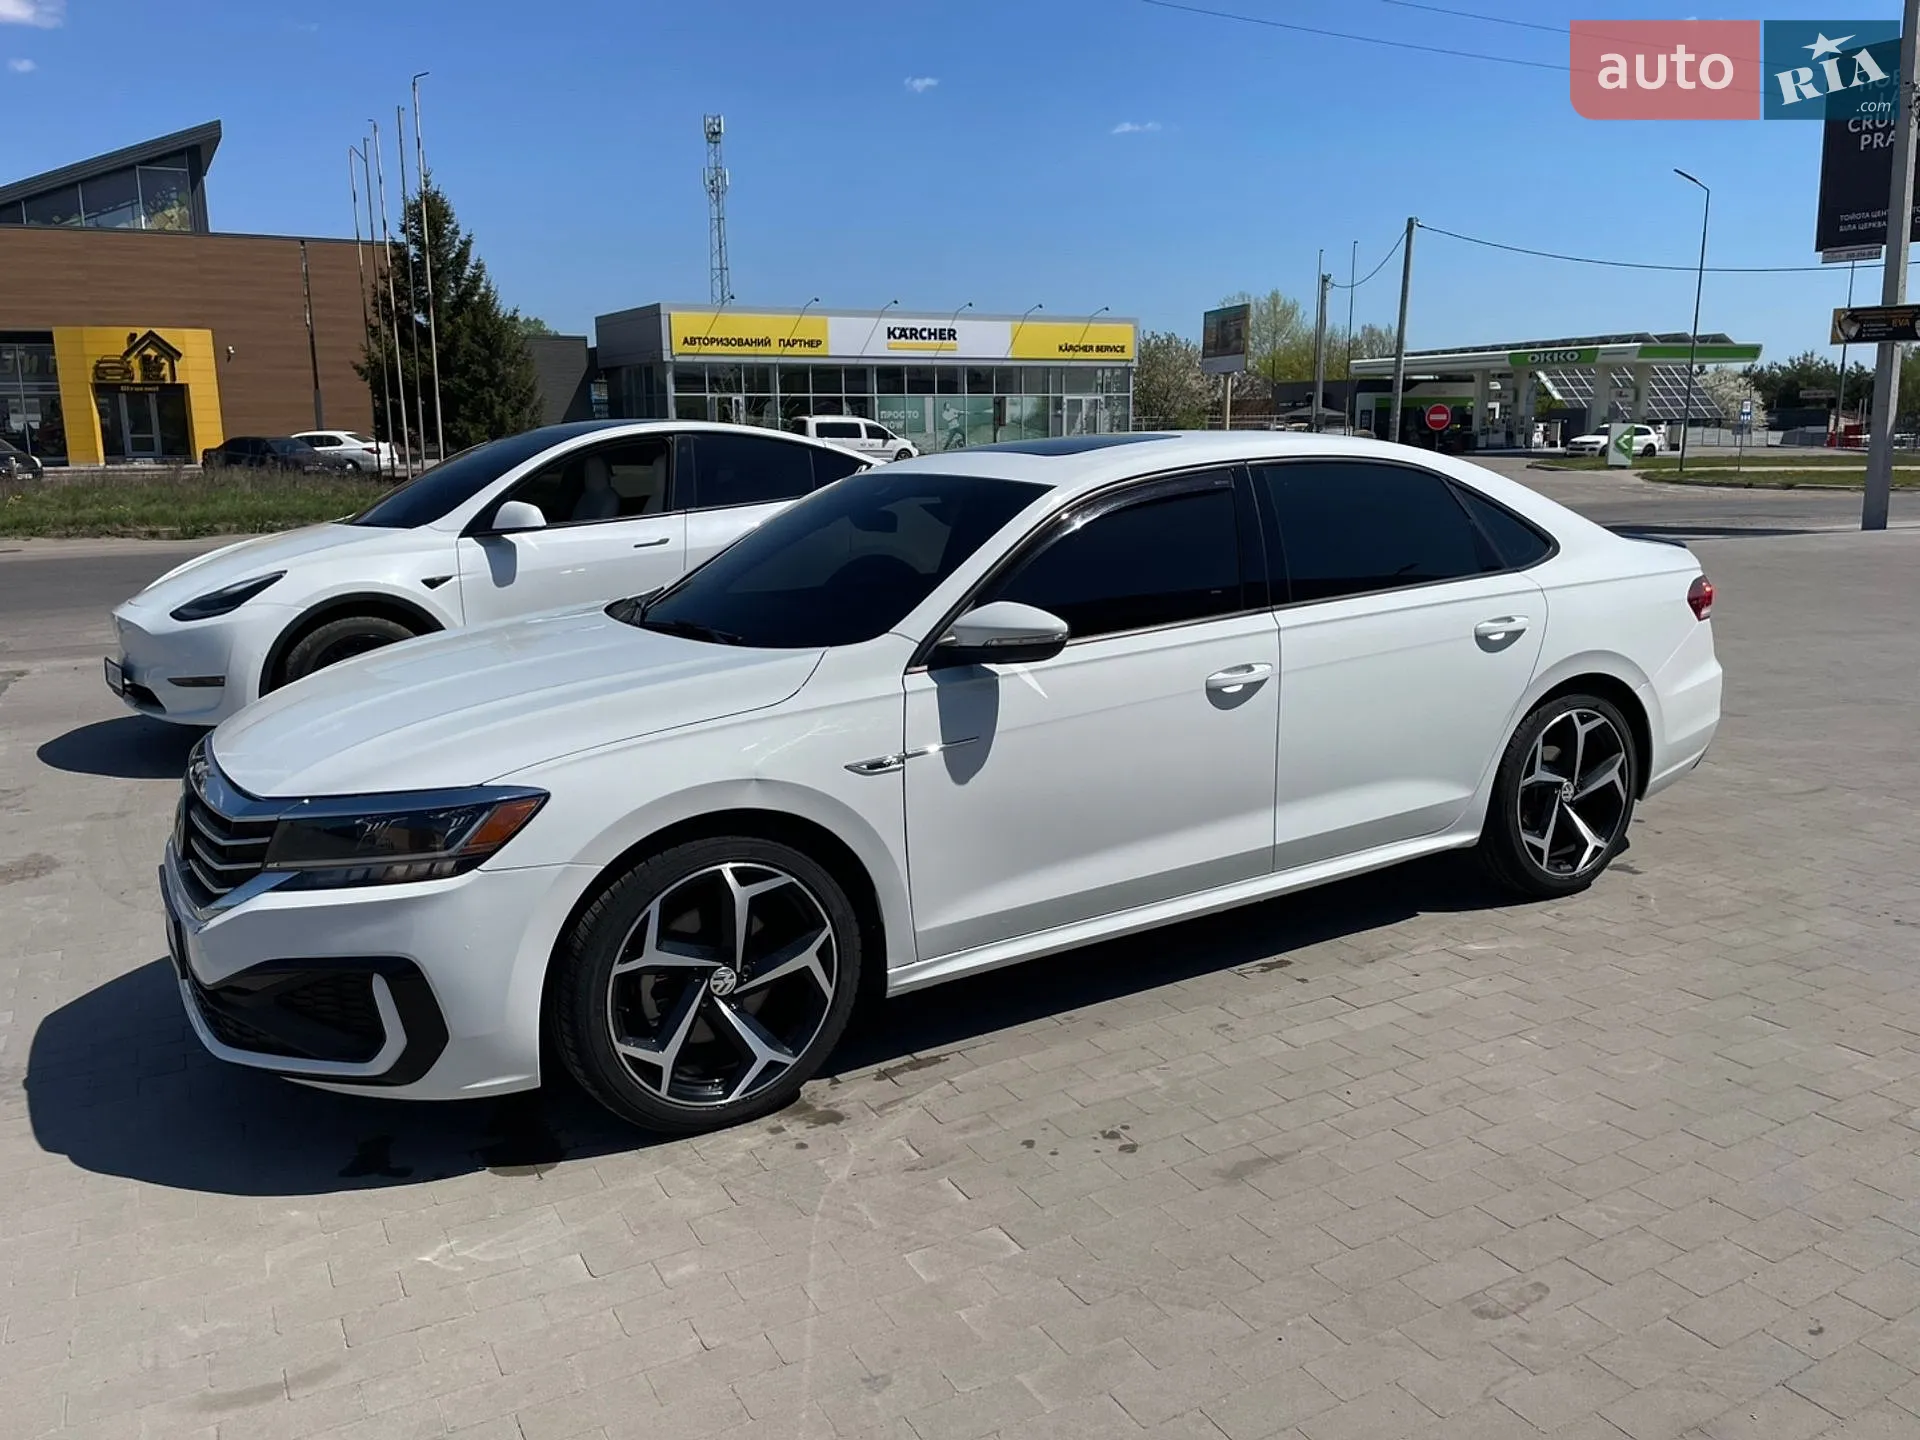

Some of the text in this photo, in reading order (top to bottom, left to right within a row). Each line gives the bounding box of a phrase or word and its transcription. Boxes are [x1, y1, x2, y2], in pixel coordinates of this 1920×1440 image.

[1848, 110, 1896, 132] CRUI
[1860, 130, 1897, 151] PRA
[1871, 209, 1888, 219] ЦЕН
[886, 326, 958, 341] KÄRCHER
[682, 335, 823, 349] АВТОРИЗОВАНИЙ ПАРТНЕР
[1058, 342, 1126, 353] KÄRCHER SERVICE
[1527, 351, 1579, 364] OKKO
